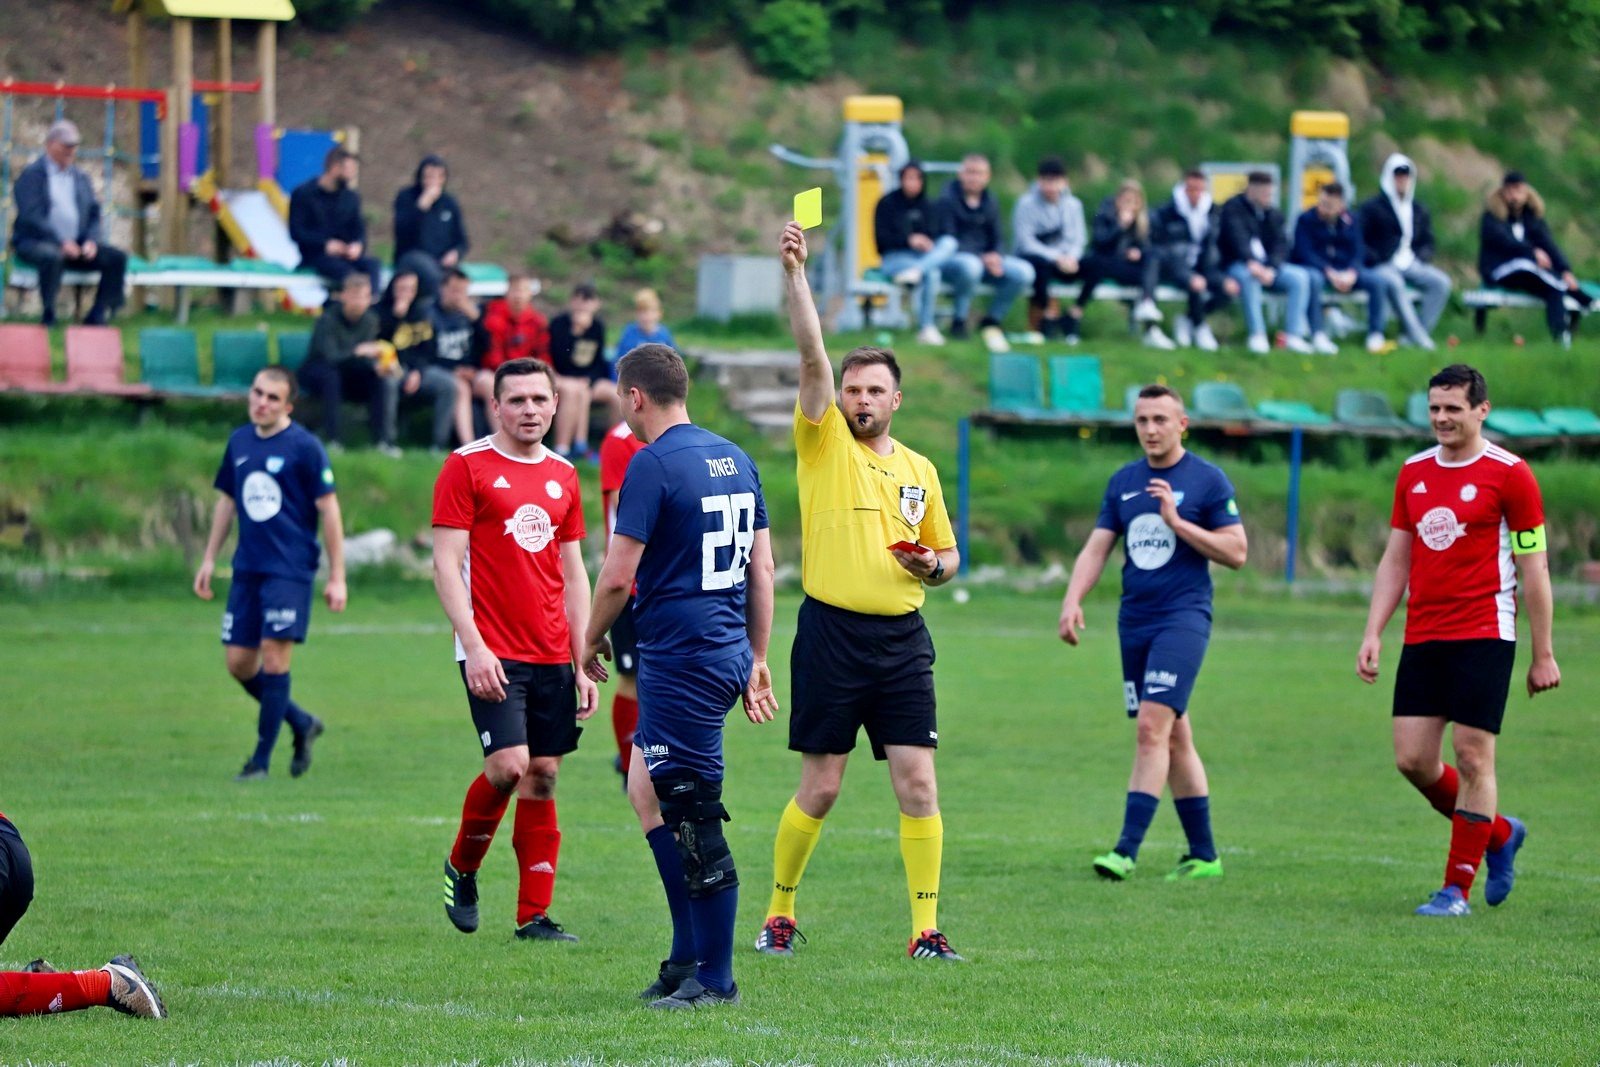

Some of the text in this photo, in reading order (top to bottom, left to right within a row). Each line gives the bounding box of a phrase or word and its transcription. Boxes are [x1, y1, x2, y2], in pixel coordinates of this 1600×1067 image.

[705, 457, 739, 478] ZYNER
[701, 492, 756, 591] 28
[1516, 528, 1537, 549] C
[481, 731, 492, 748] 10
